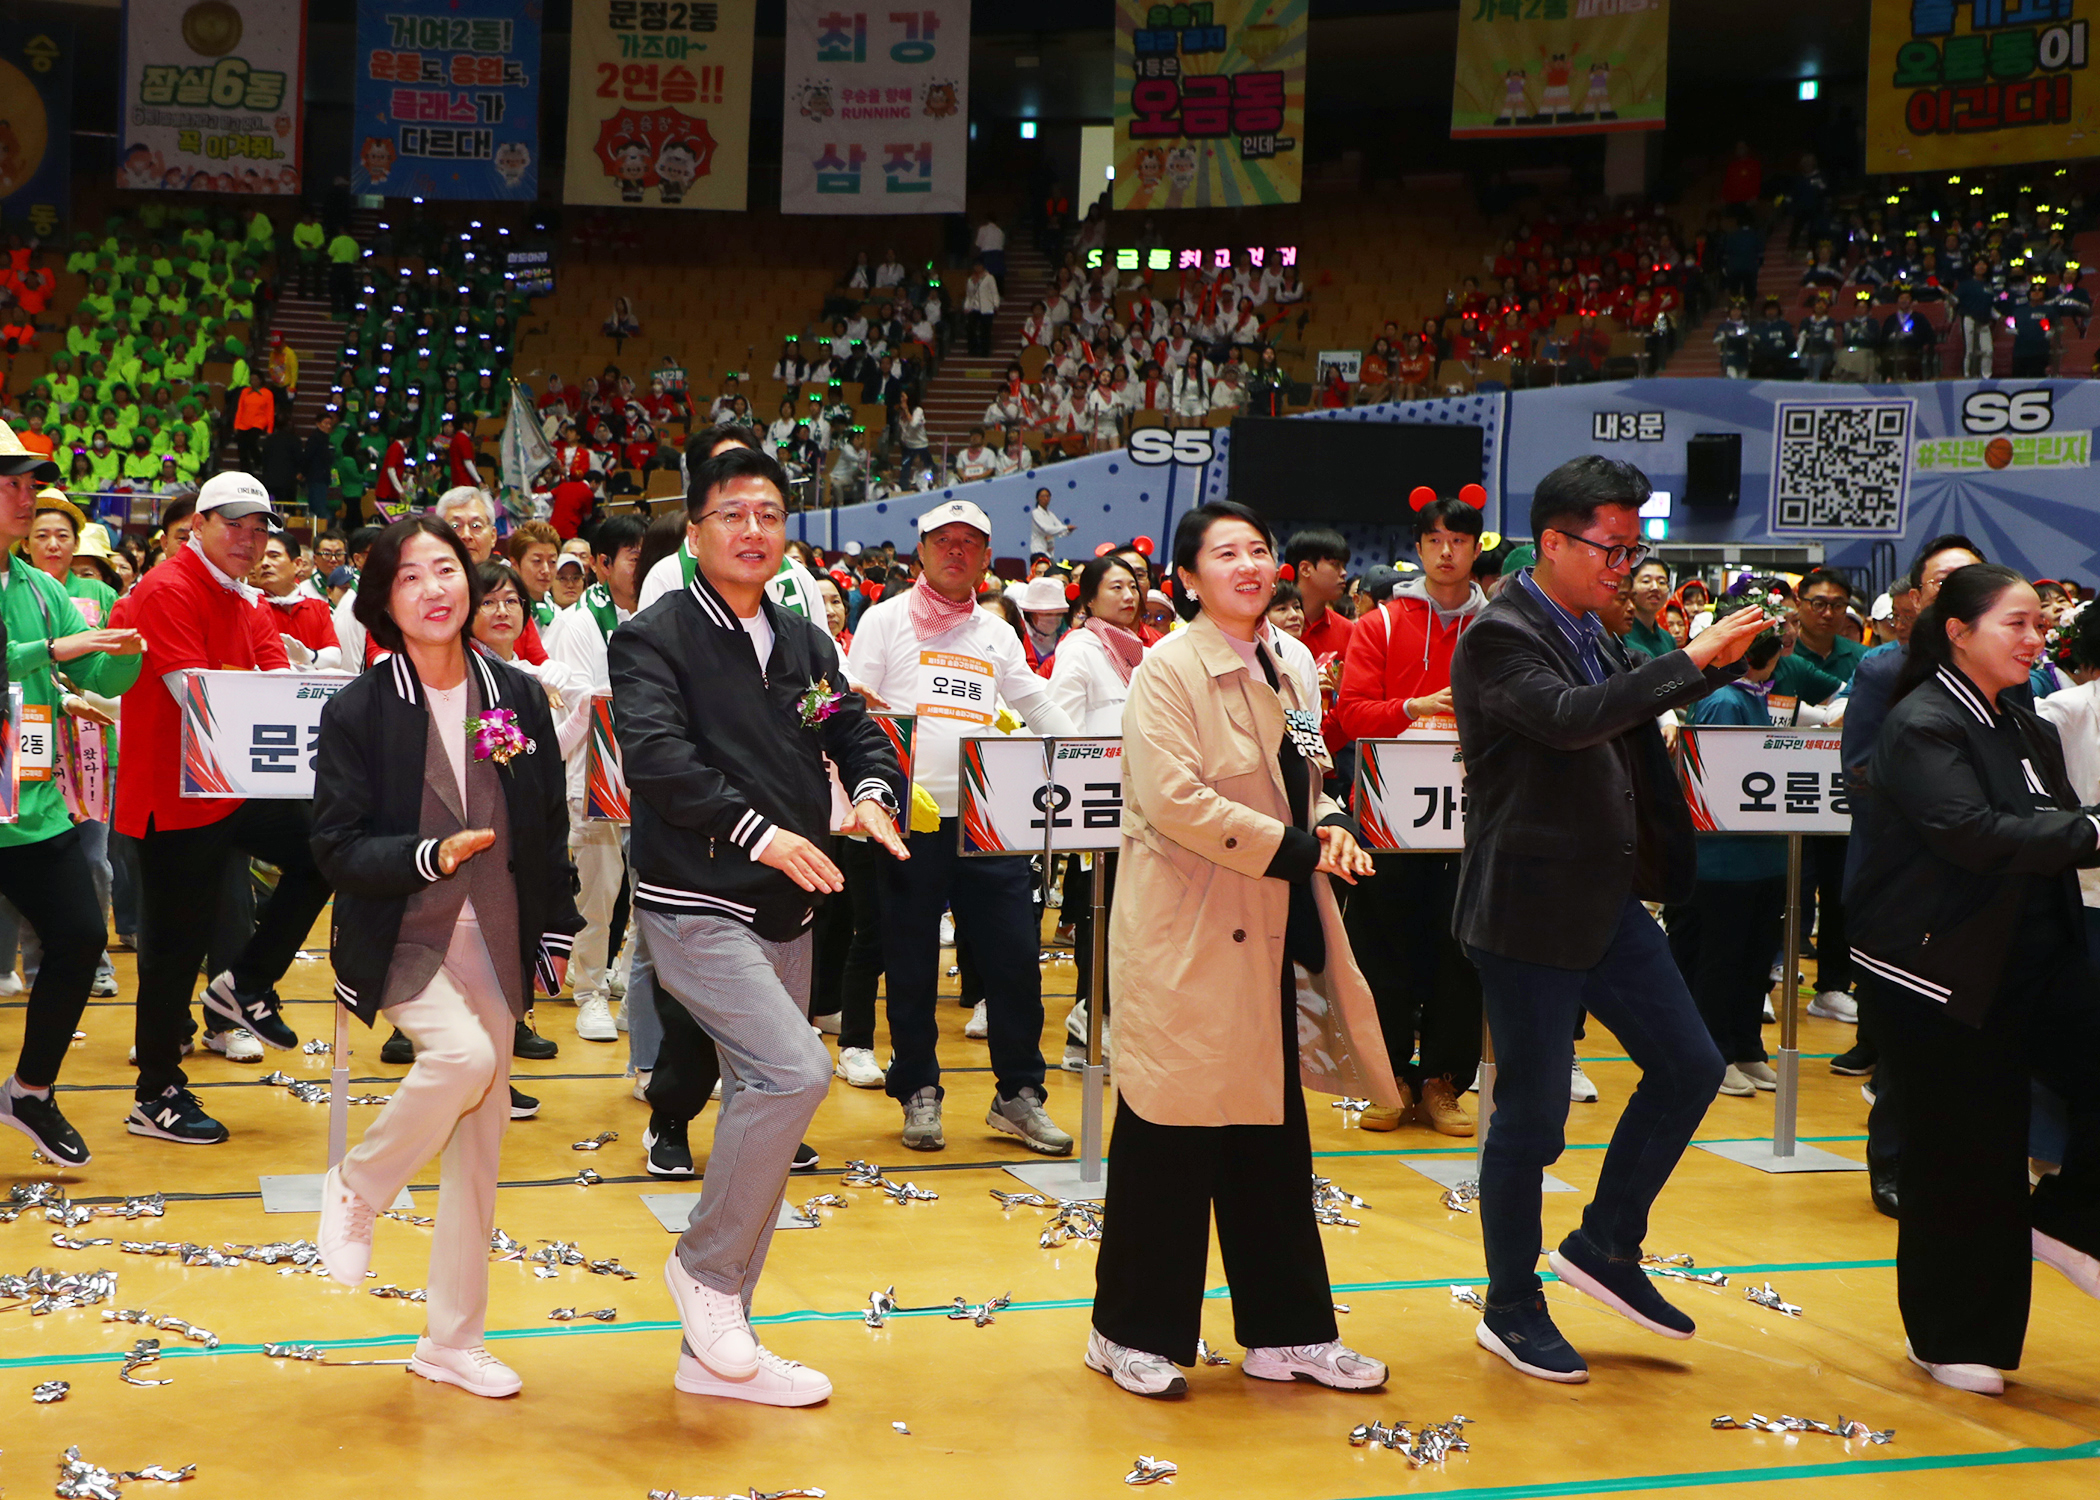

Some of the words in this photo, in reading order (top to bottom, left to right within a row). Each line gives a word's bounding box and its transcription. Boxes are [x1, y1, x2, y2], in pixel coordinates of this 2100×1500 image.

[609, 0, 718, 32] 문정2동
[386, 14, 513, 53] 거여2동!
[617, 35, 708, 60] 가즈아~
[370, 50, 448, 87] 운동도,
[451, 54, 529, 88] 응원도,
[1893, 19, 2089, 88] 오륜동이
[141, 57, 287, 112] 잠실6동
[596, 62, 725, 104] 2연승!!
[841, 87, 881, 104] 우승을
[885, 87, 912, 103] 향해
[390, 88, 506, 123] 클래스가
[841, 106, 912, 120] RUNNING
[1131, 72, 1284, 138] 오금동
[1906, 74, 2072, 136] 이긴다!
[178, 129, 202, 156] 꼭
[400, 125, 493, 160] 다르다!
[27, 203, 59, 236] 동
[1593, 412, 1664, 441] 내3문
[1963, 389, 2053, 434] S6
[1129, 427, 1214, 466] S5
[1917, 440, 1985, 468] #직관
[2012, 435, 2088, 466] 챌린지
[931, 676, 982, 702] 오금동
[1284, 709, 1320, 734] 구의원
[1057, 747, 1104, 759] 송파구민
[1289, 729, 1328, 758] 정주리
[1764, 738, 1804, 750] 송파구민
[1413, 786, 1467, 831] 가
[1739, 771, 1852, 814] 오륜동
